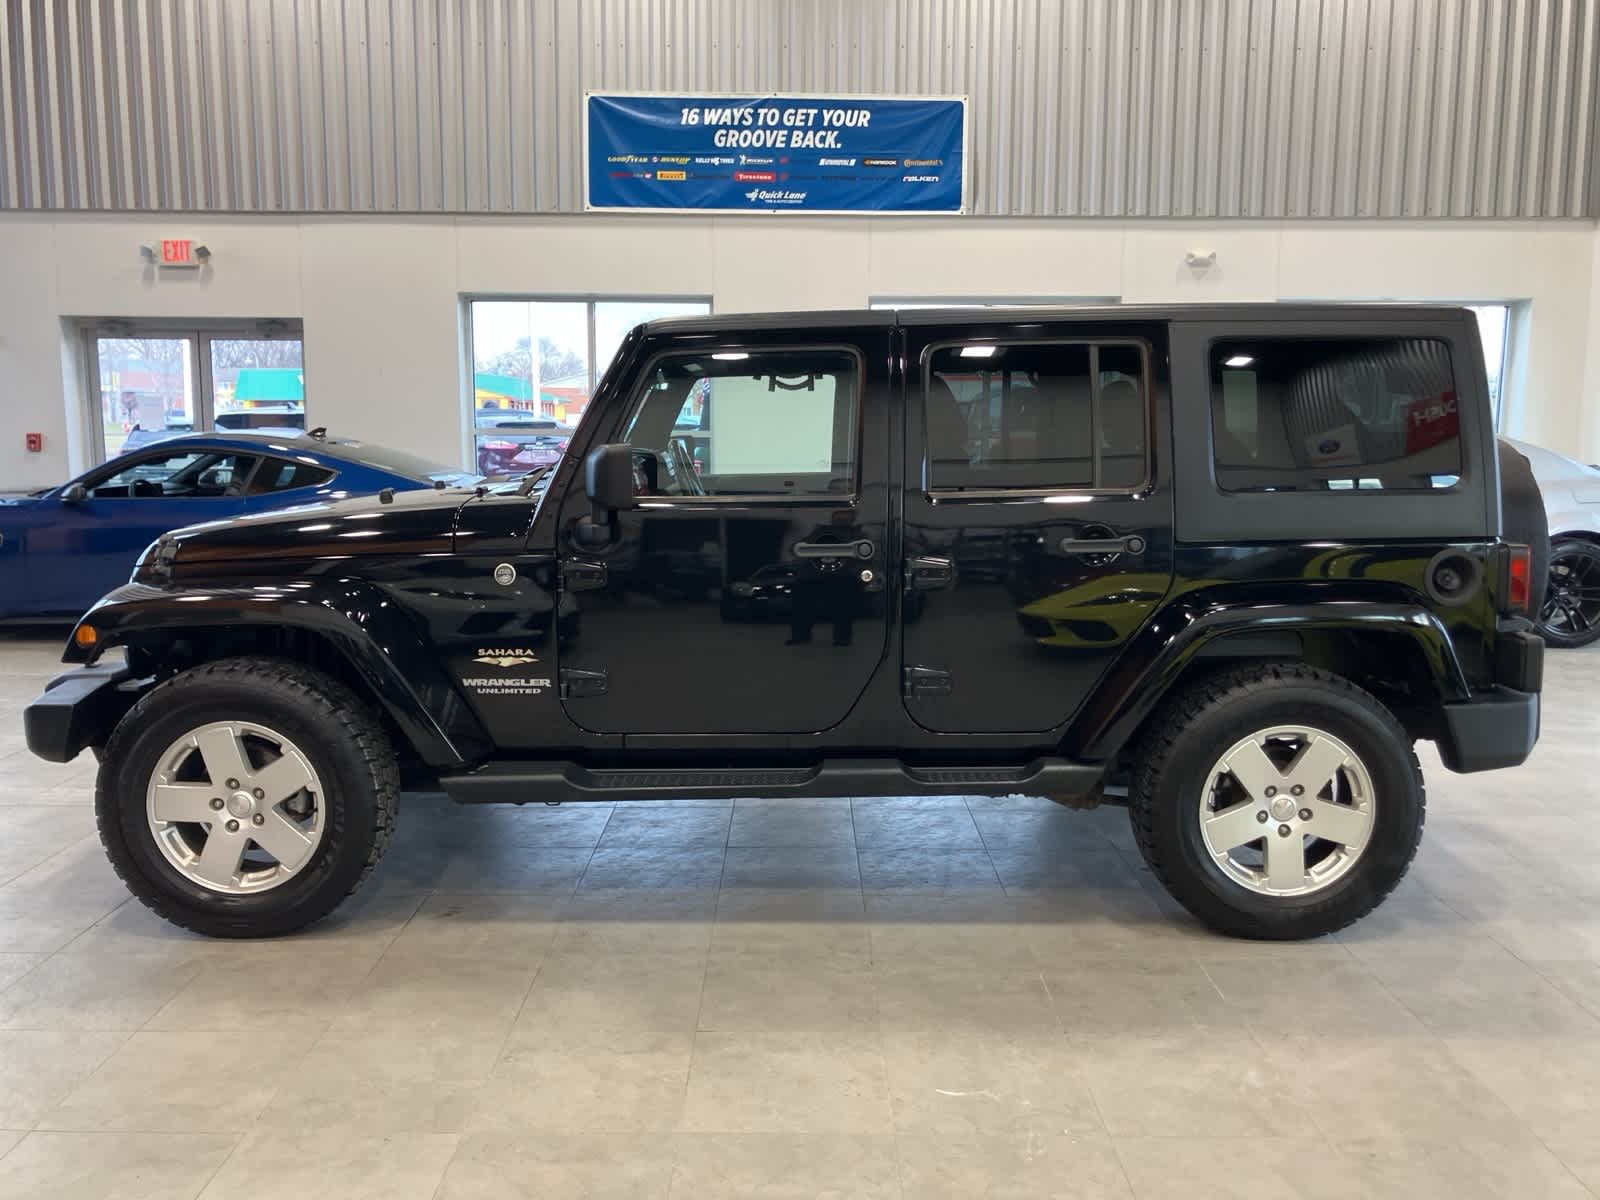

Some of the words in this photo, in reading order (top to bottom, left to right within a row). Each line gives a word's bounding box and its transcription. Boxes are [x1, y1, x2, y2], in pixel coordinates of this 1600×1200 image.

[680, 108, 699, 125] 16
[703, 108, 754, 126] WAYS
[757, 109, 780, 126] TO
[783, 109, 819, 127] GET
[822, 109, 871, 128] YOUR
[713, 129, 788, 148] GROOVE
[790, 130, 842, 149] BACK.
[758, 190, 784, 199] Quick
[784, 191, 807, 200] Lane
[163, 240, 191, 262] EXIT
[478, 648, 534, 656] SAHARA
[462, 678, 552, 687] WRANGLER
